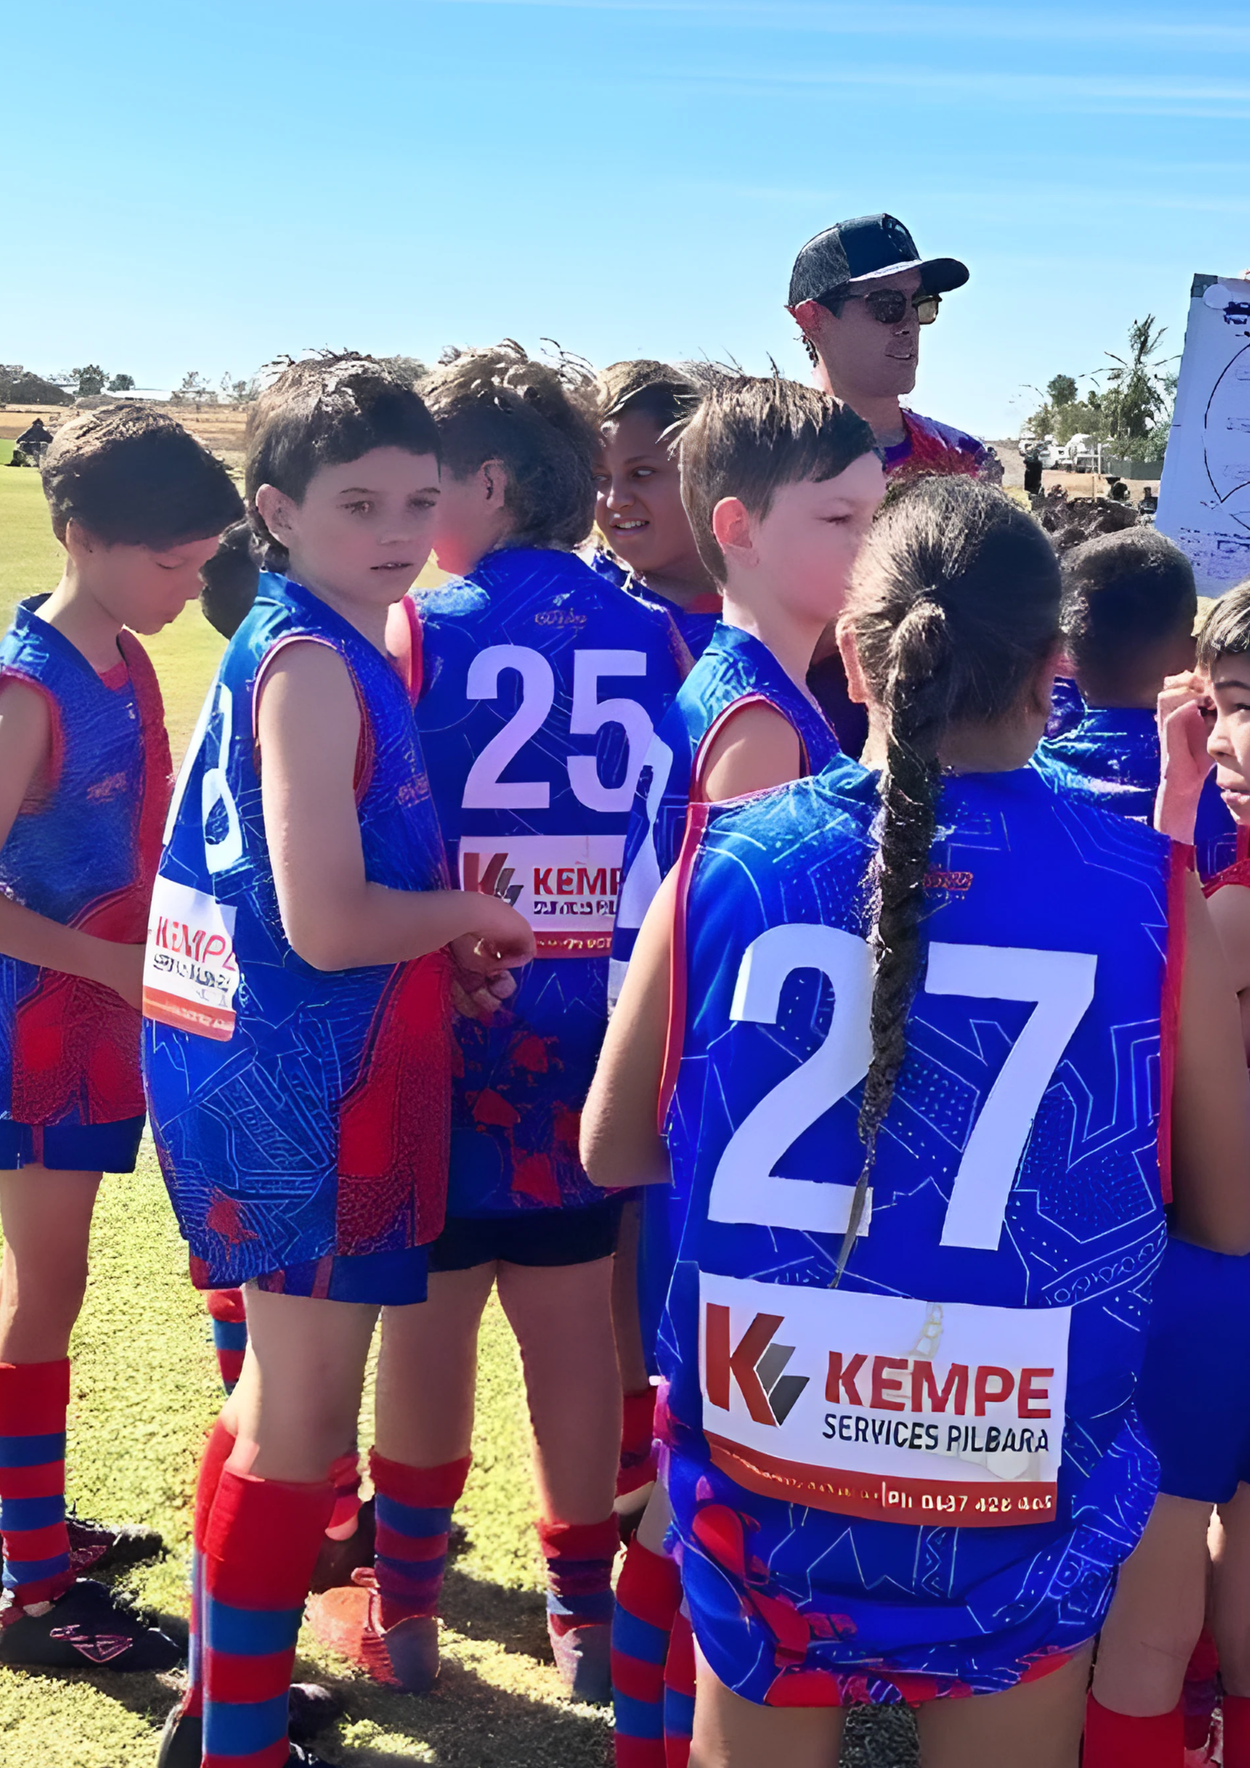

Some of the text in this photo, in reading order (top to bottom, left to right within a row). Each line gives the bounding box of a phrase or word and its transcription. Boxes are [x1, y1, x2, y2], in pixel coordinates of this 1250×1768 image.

[461, 644, 654, 812] 25
[707, 923, 1098, 1251] 27
[821, 1412, 1050, 1453] SERVICES PILBARA
[824, 1350, 1055, 1419] KEMPE
